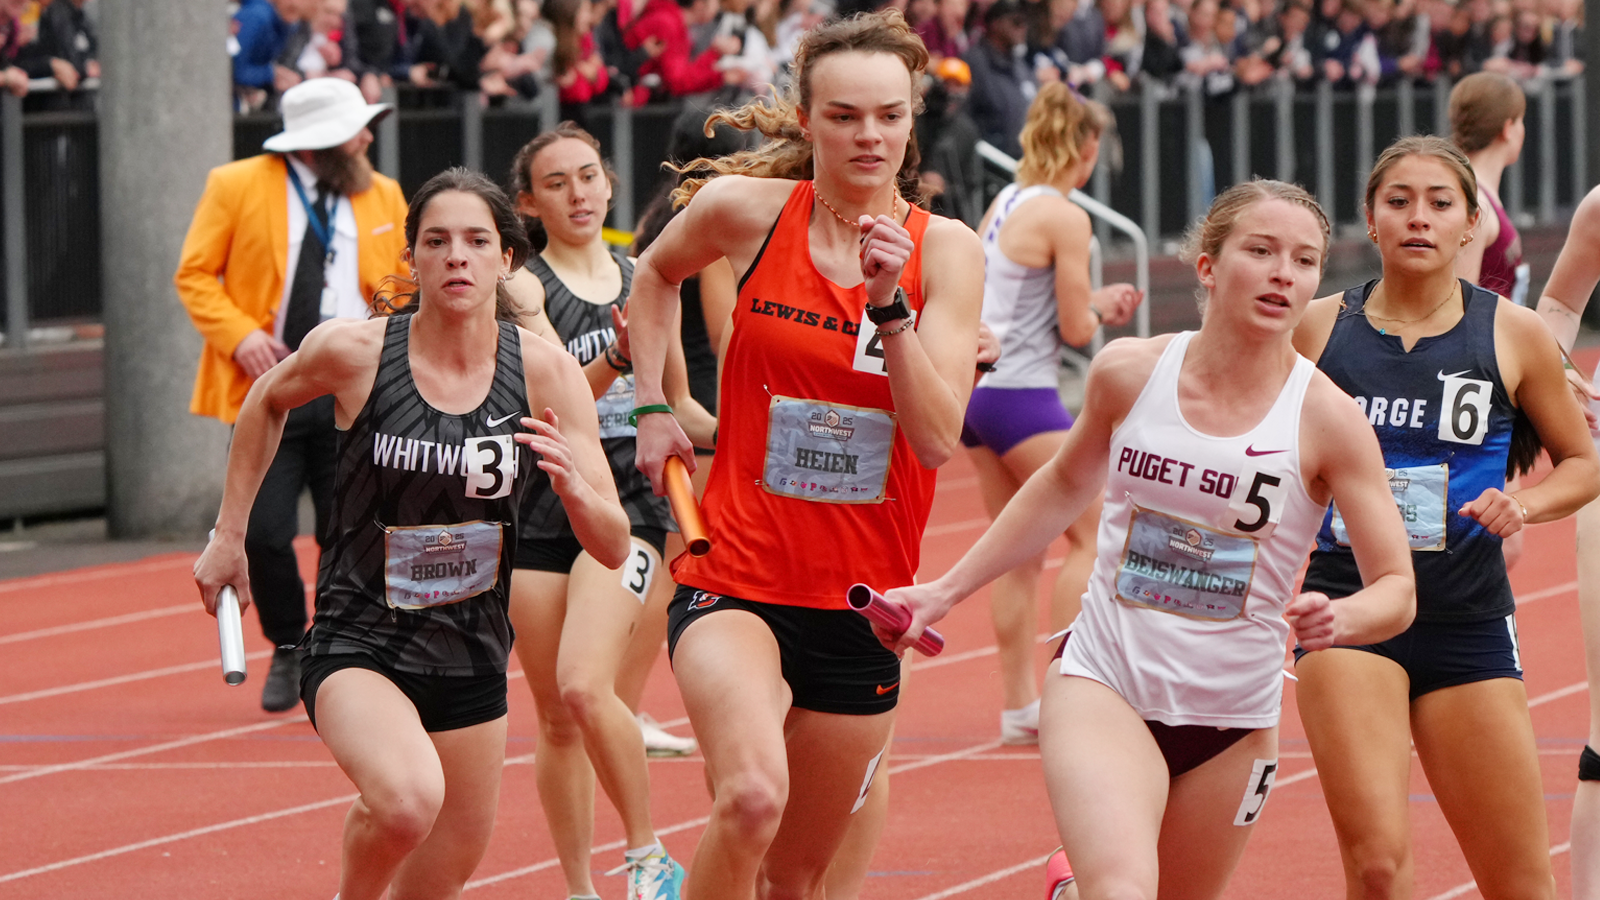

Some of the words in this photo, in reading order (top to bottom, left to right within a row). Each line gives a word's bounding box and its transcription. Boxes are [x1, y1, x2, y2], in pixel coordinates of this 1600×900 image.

[750, 298, 820, 326] LEWIS
[822, 316, 838, 332] &
[811, 412, 821, 421] 20
[1451, 382, 1482, 441] 6
[809, 425, 853, 438] NORTHWEST
[475, 440, 504, 497] 3
[794, 447, 859, 475] HEIEN
[1117, 446, 1196, 488] PUGET
[1233, 471, 1282, 533] 5
[425, 542, 465, 553] NORTHWEST
[1169, 539, 1214, 559] NORTHWEST
[410, 558, 477, 582] BROWN
[629, 550, 651, 595] 3
[1124, 549, 1247, 598] BEISWANGER
[1244, 763, 1277, 823] 5
